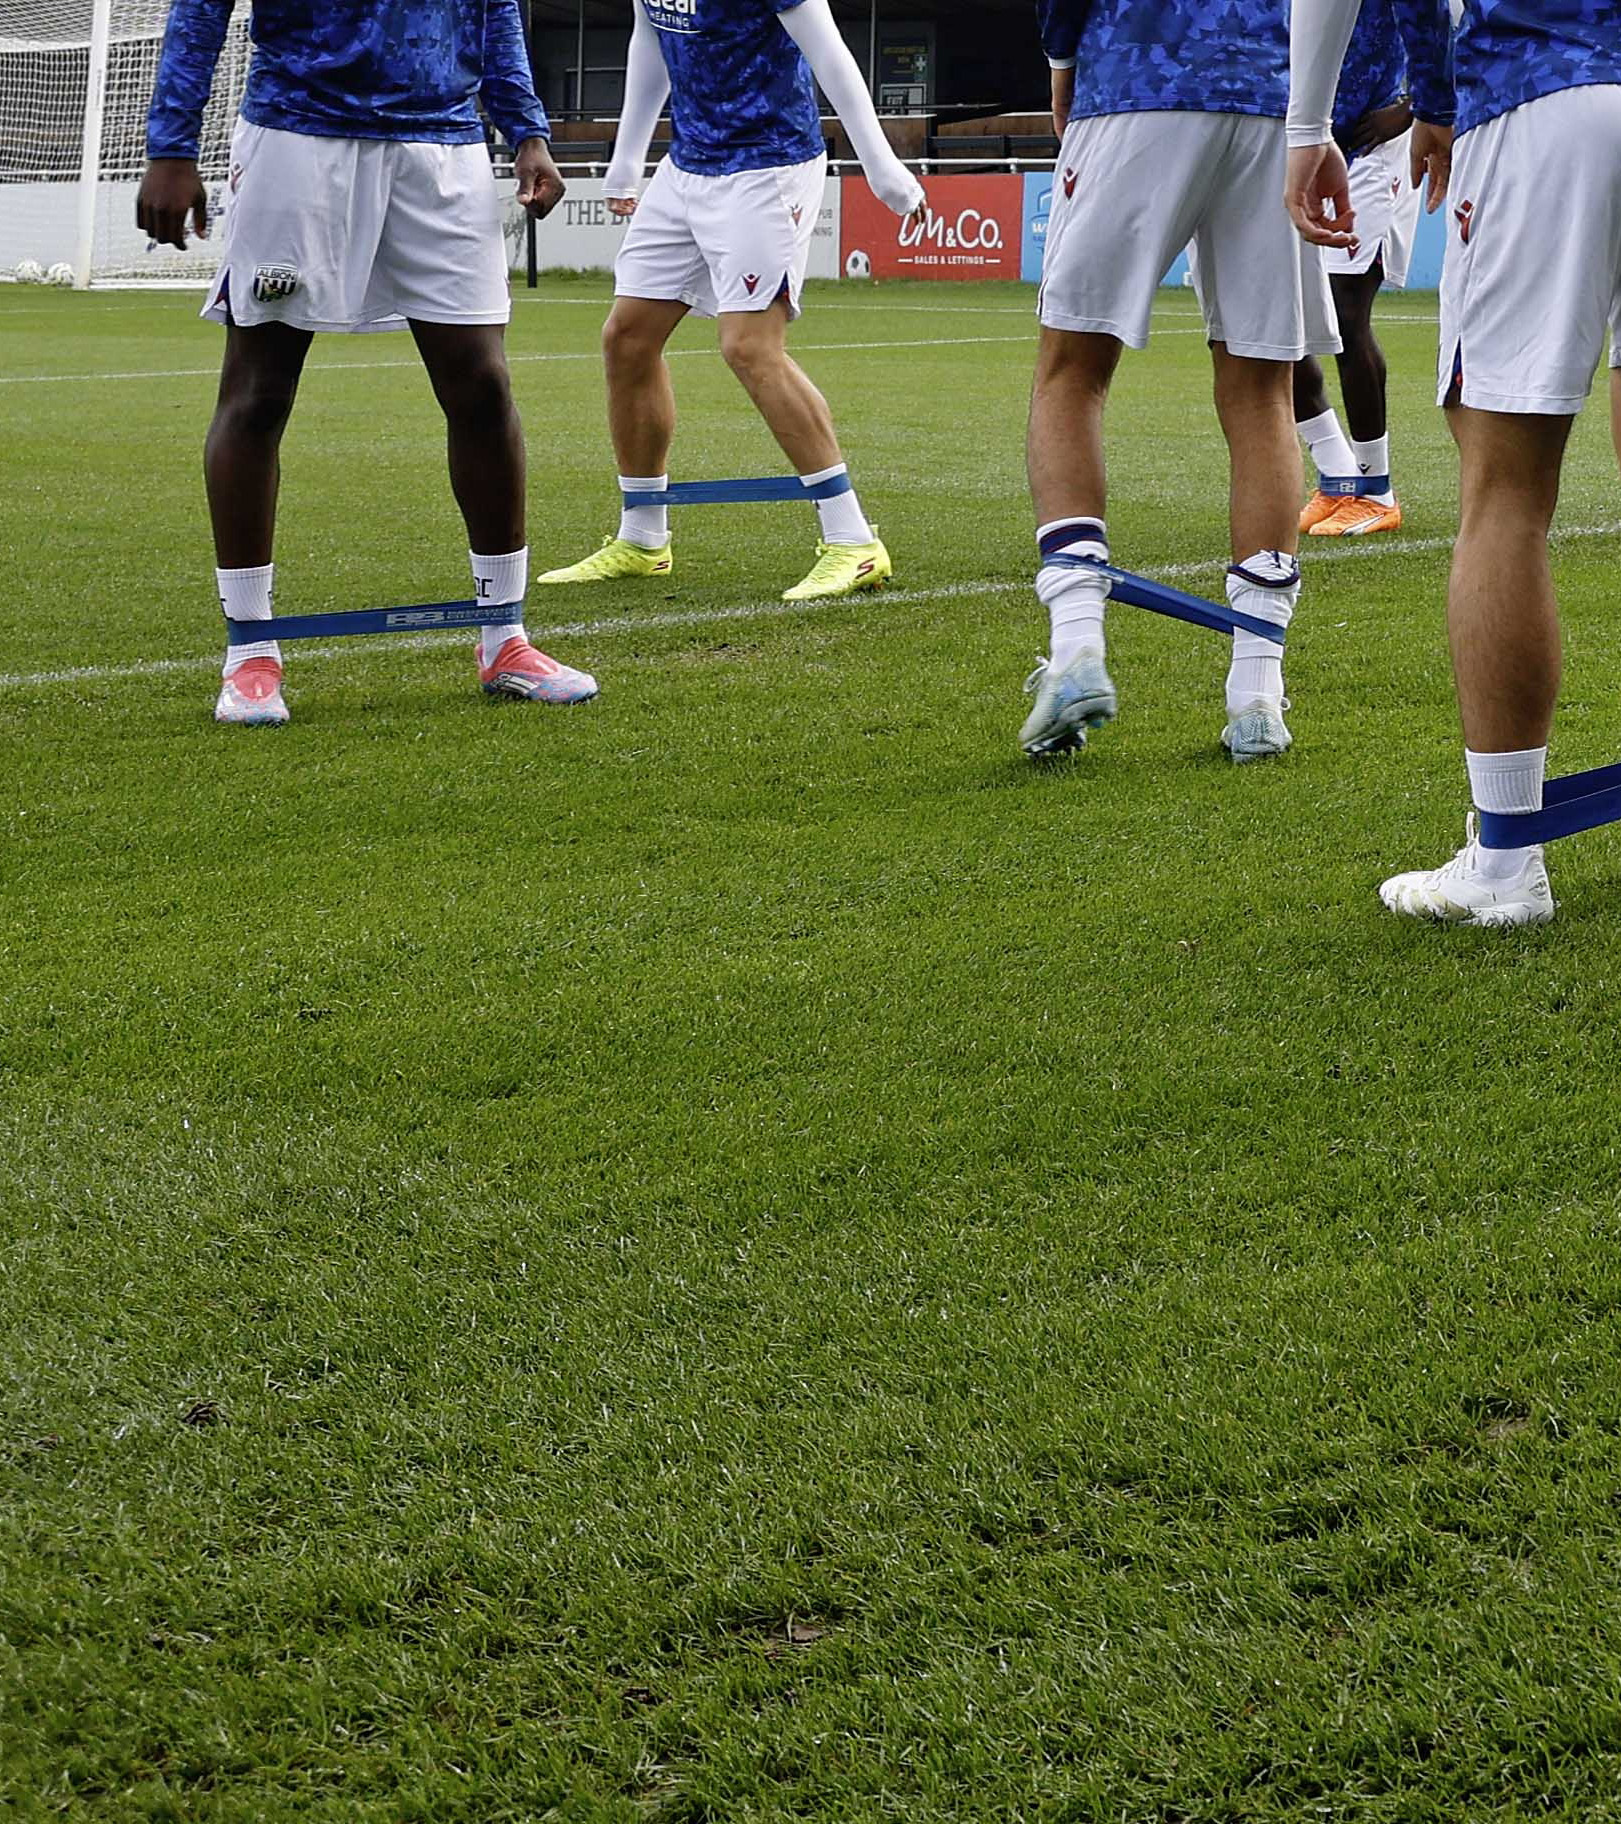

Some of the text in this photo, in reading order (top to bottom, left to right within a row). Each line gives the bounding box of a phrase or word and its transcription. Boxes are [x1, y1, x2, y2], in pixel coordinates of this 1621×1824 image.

[562, 199, 605, 225] THE
[914, 256, 985, 265] SALES & LETTINGS
